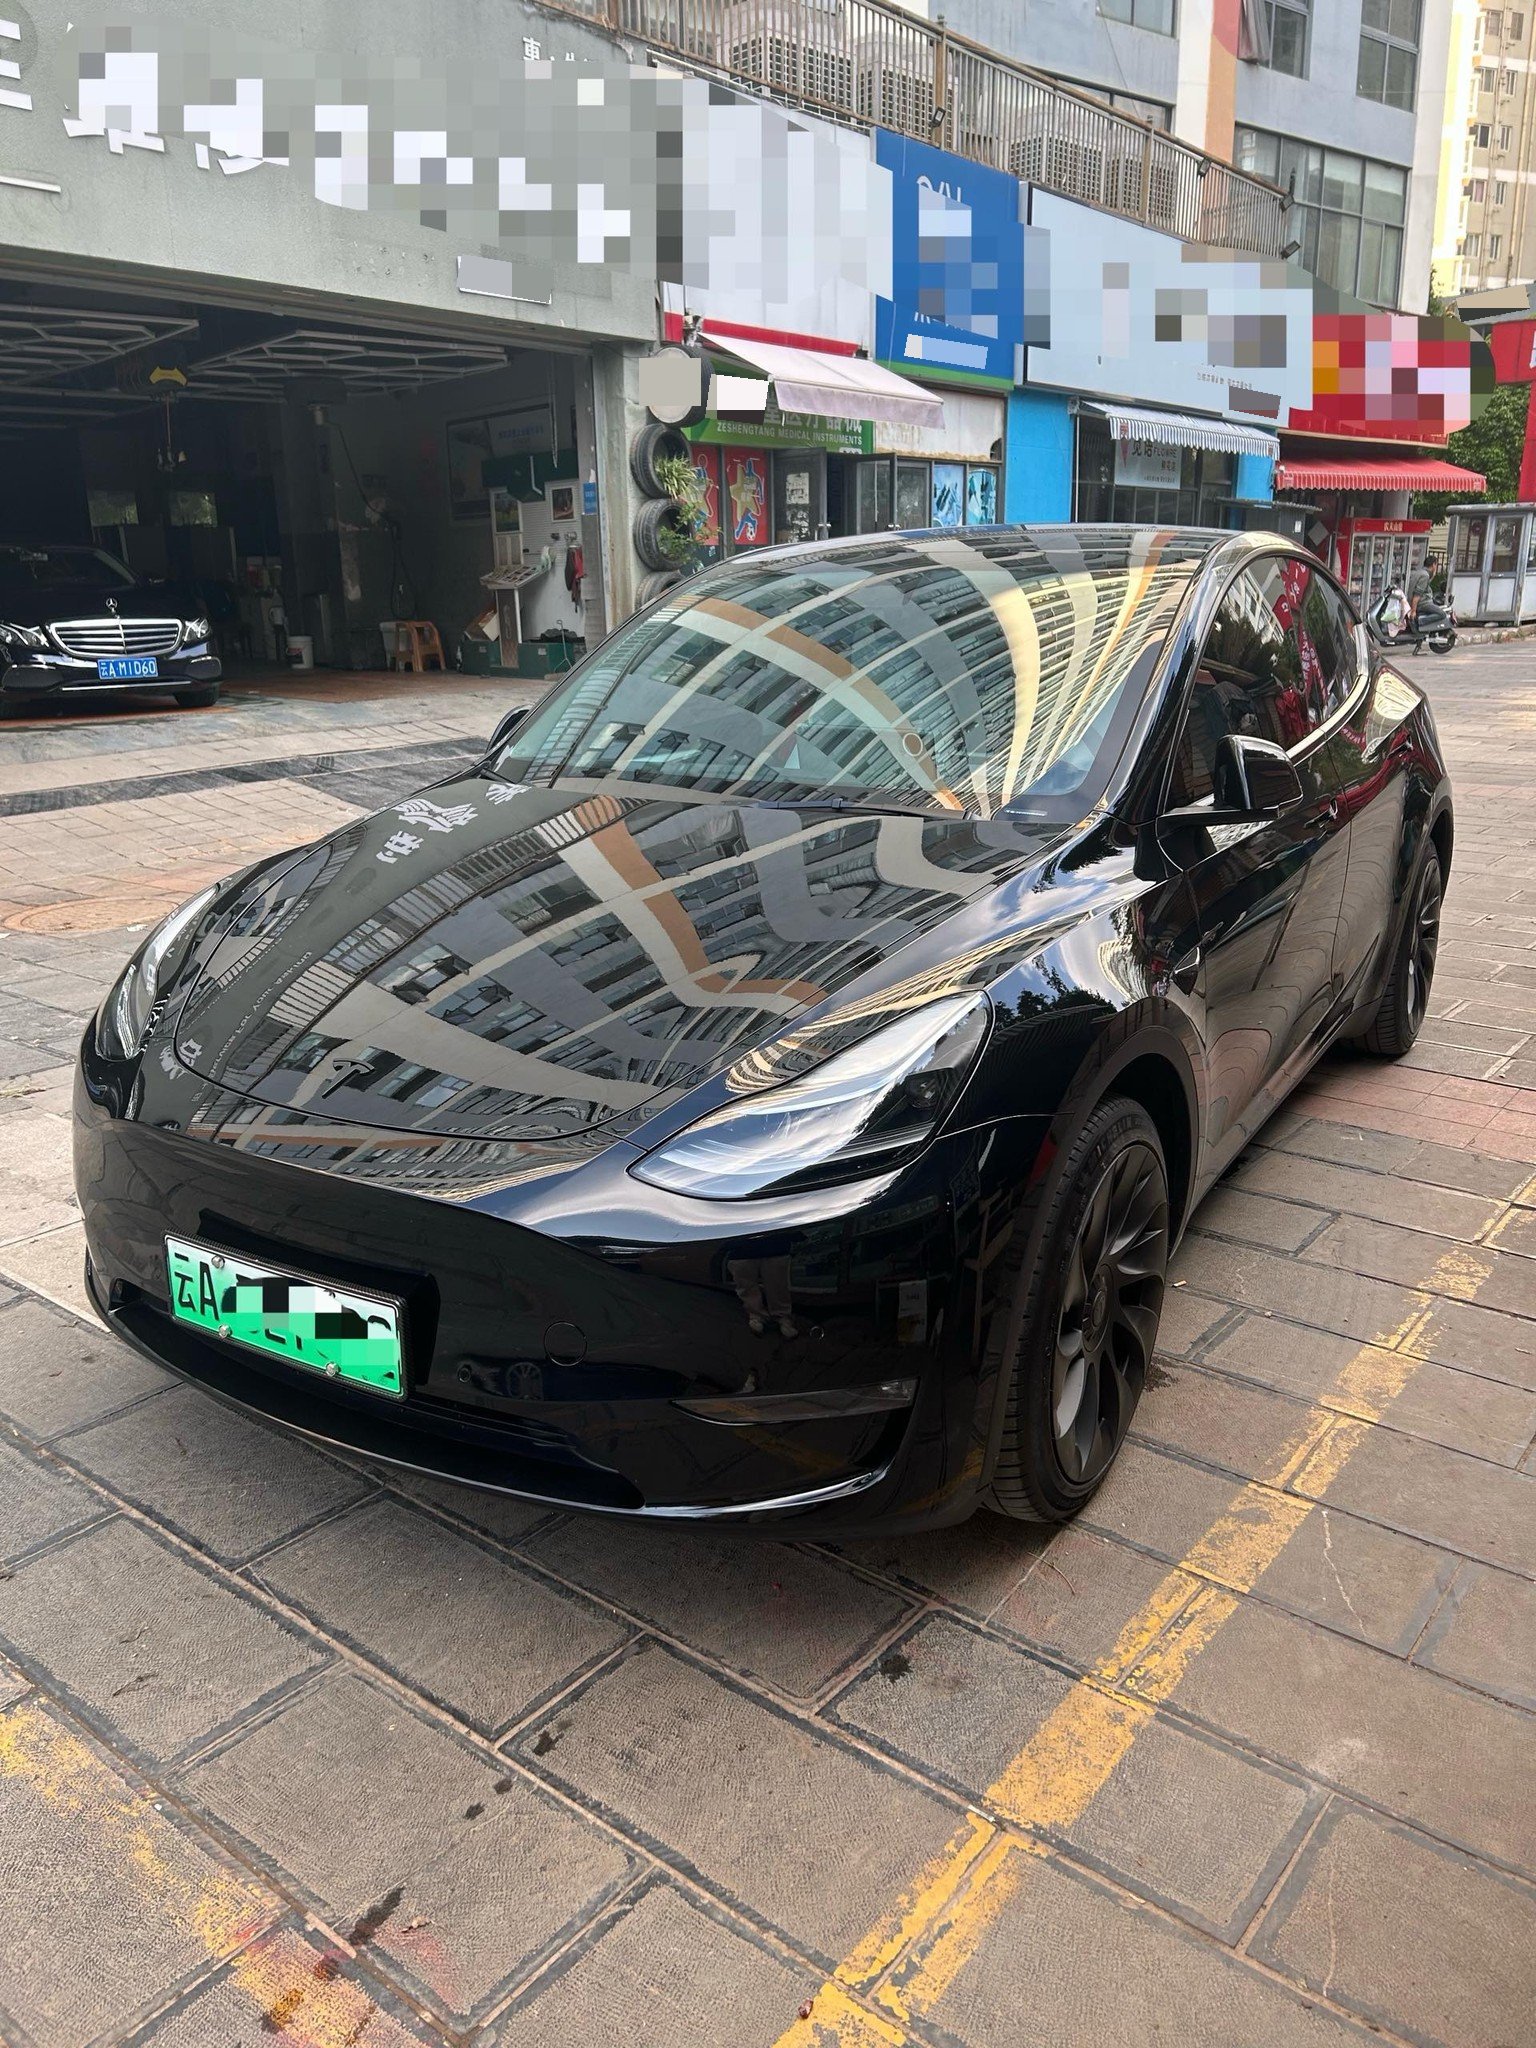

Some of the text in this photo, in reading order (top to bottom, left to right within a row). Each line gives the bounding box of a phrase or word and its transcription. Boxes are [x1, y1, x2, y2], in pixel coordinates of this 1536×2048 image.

[717, 422, 863, 446] ZESHENGTANG MEDICAL INSTRUMENTS
